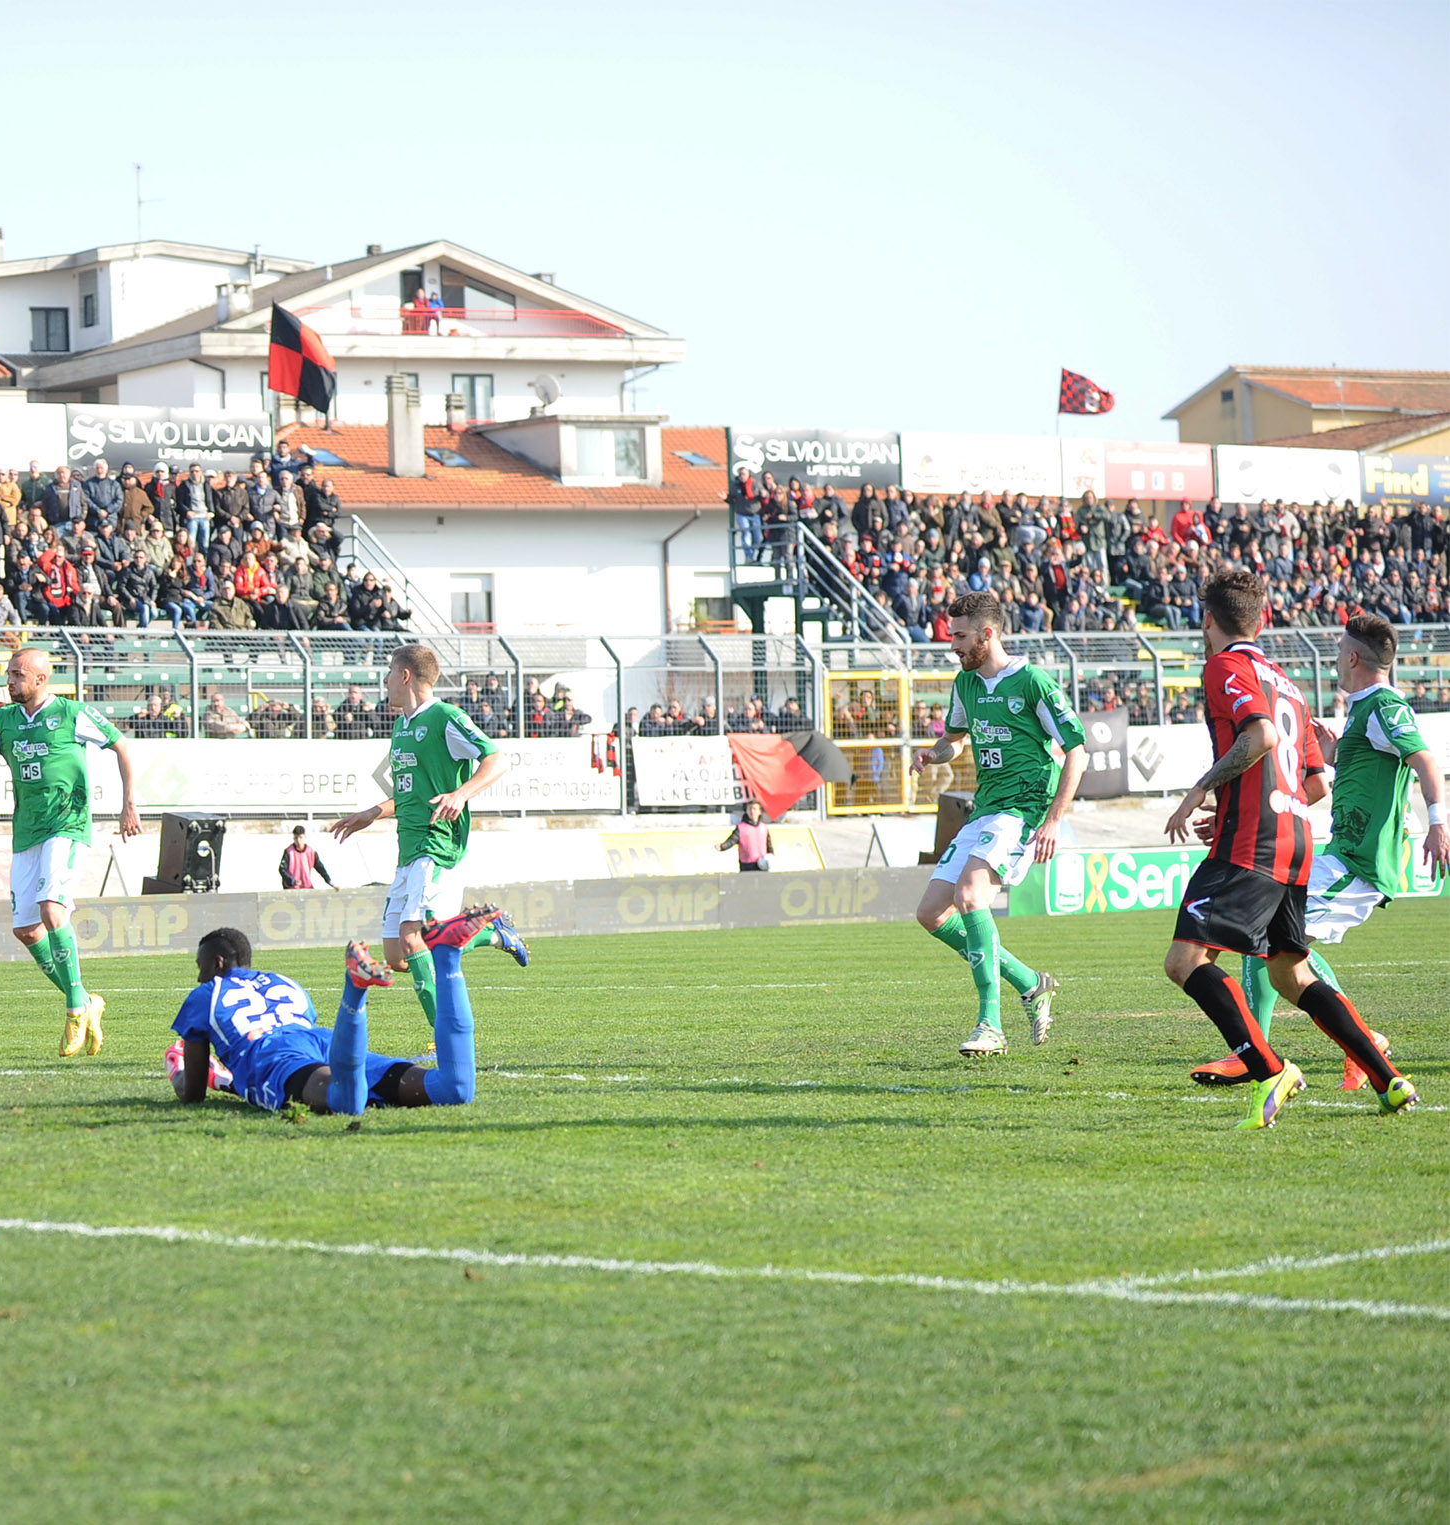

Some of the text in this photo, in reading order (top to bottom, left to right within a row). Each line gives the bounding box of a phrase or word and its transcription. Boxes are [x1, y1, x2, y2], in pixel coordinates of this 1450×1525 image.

[107, 419, 272, 448] SILVIO LUCIANI
[765, 439, 900, 465] SILVIO LUCIANI
[1364, 456, 1430, 497] Find
[1273, 697, 1300, 794] 8
[302, 773, 358, 794] BPER
[528, 778, 615, 802] Romagna
[463, 889, 555, 929] MP
[616, 882, 720, 926] OMP
[779, 877, 879, 917] OMP
[259, 900, 377, 941] OMP
[221, 984, 313, 1037] 22
